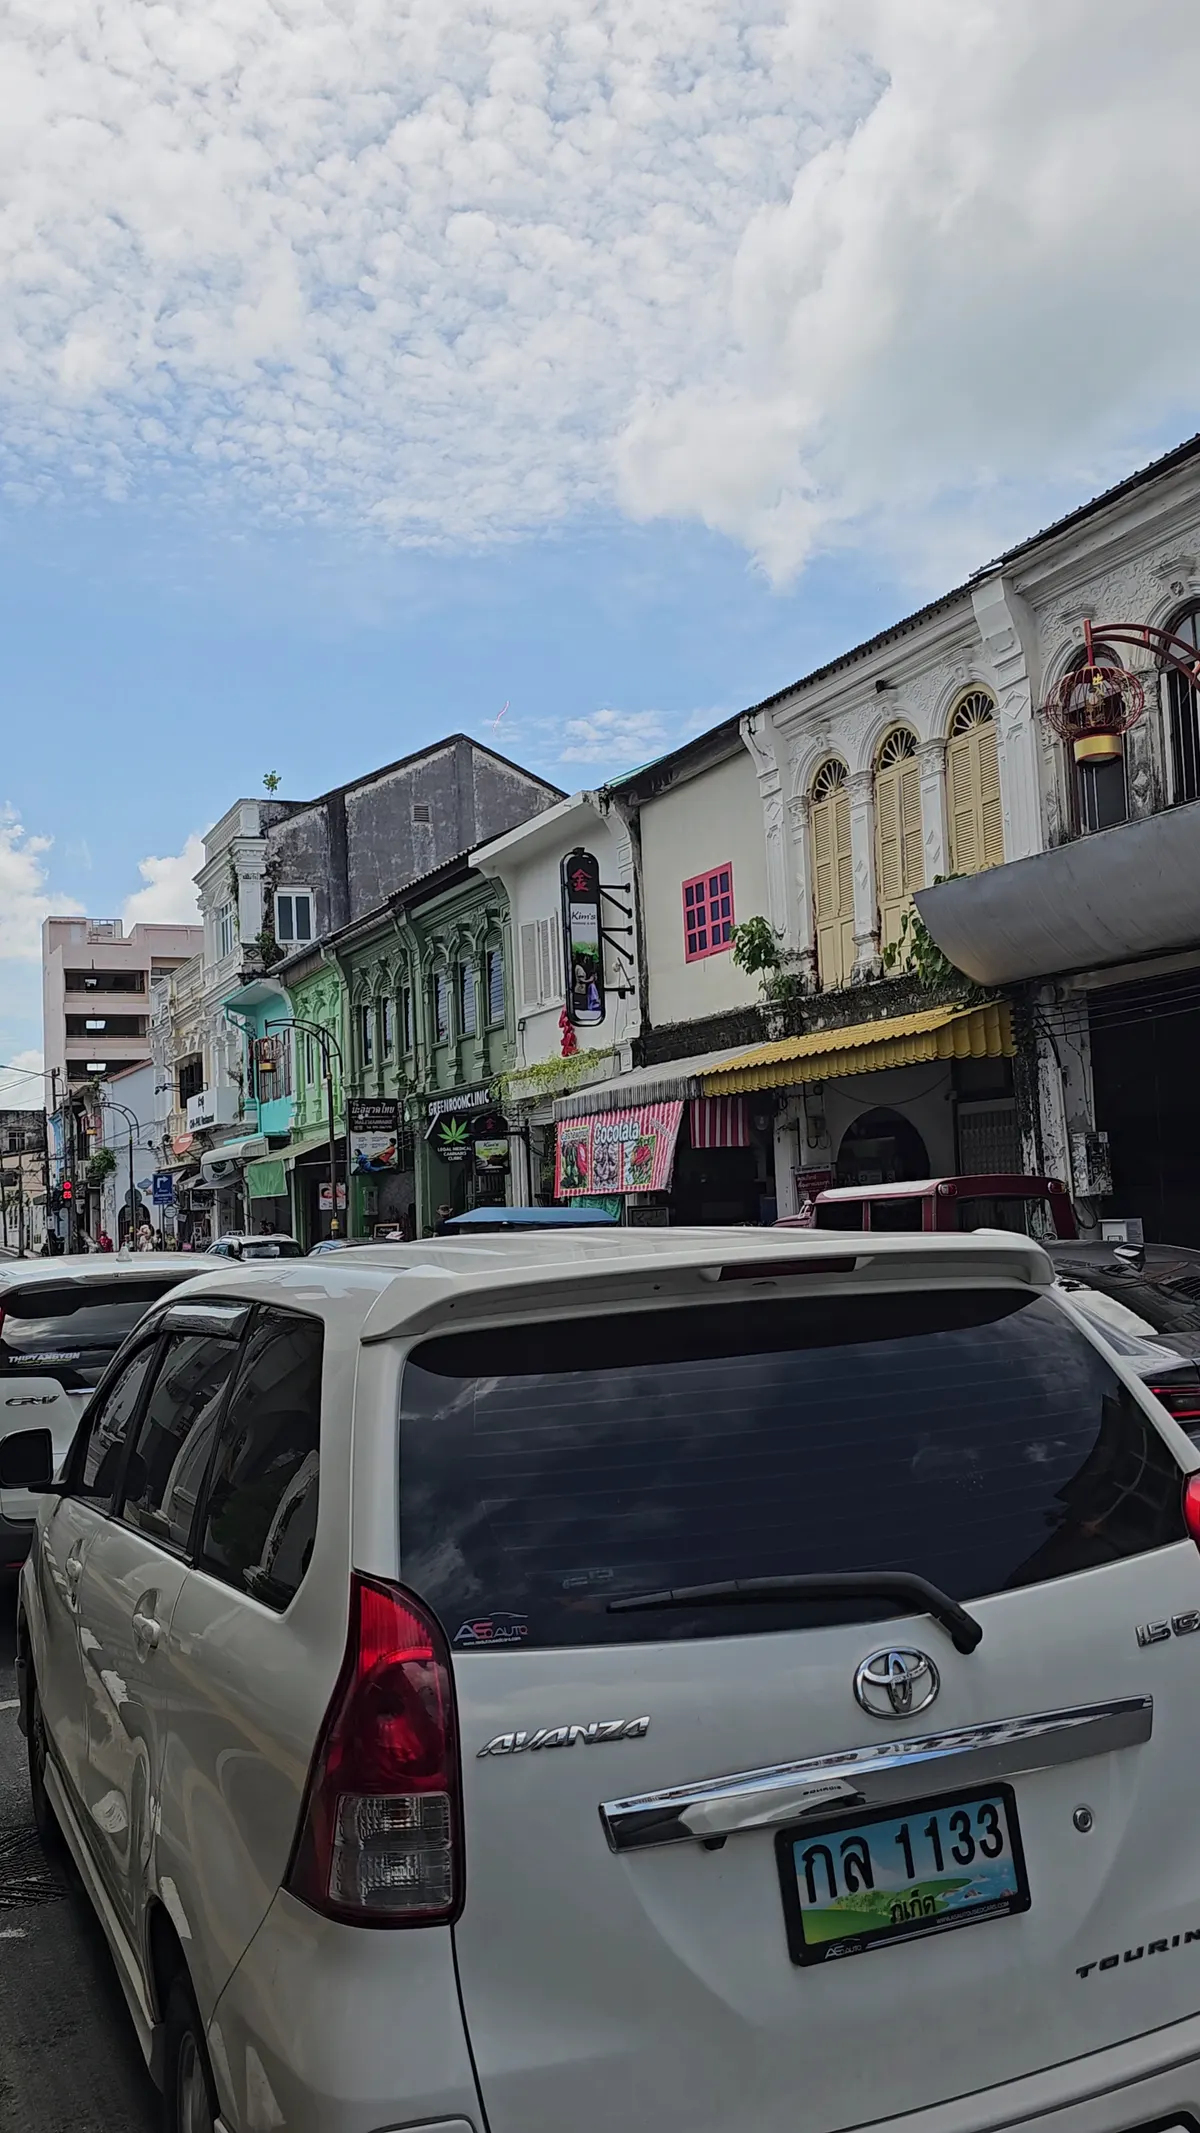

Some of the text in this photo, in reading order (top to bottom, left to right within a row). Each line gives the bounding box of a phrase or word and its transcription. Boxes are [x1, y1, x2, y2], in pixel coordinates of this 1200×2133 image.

[571, 868, 592, 891] 金
[572, 911, 596, 921] Kim's
[594, 1118, 640, 1145] Cocolala
[5, 1394, 60, 1406] CR-V
[476, 1715, 651, 1758] AVANZA
[801, 1803, 1004, 1904] กล 1133
[889, 1888, 936, 1924] ภเก็ต
[1076, 1928, 1200, 1979] TOURIN
